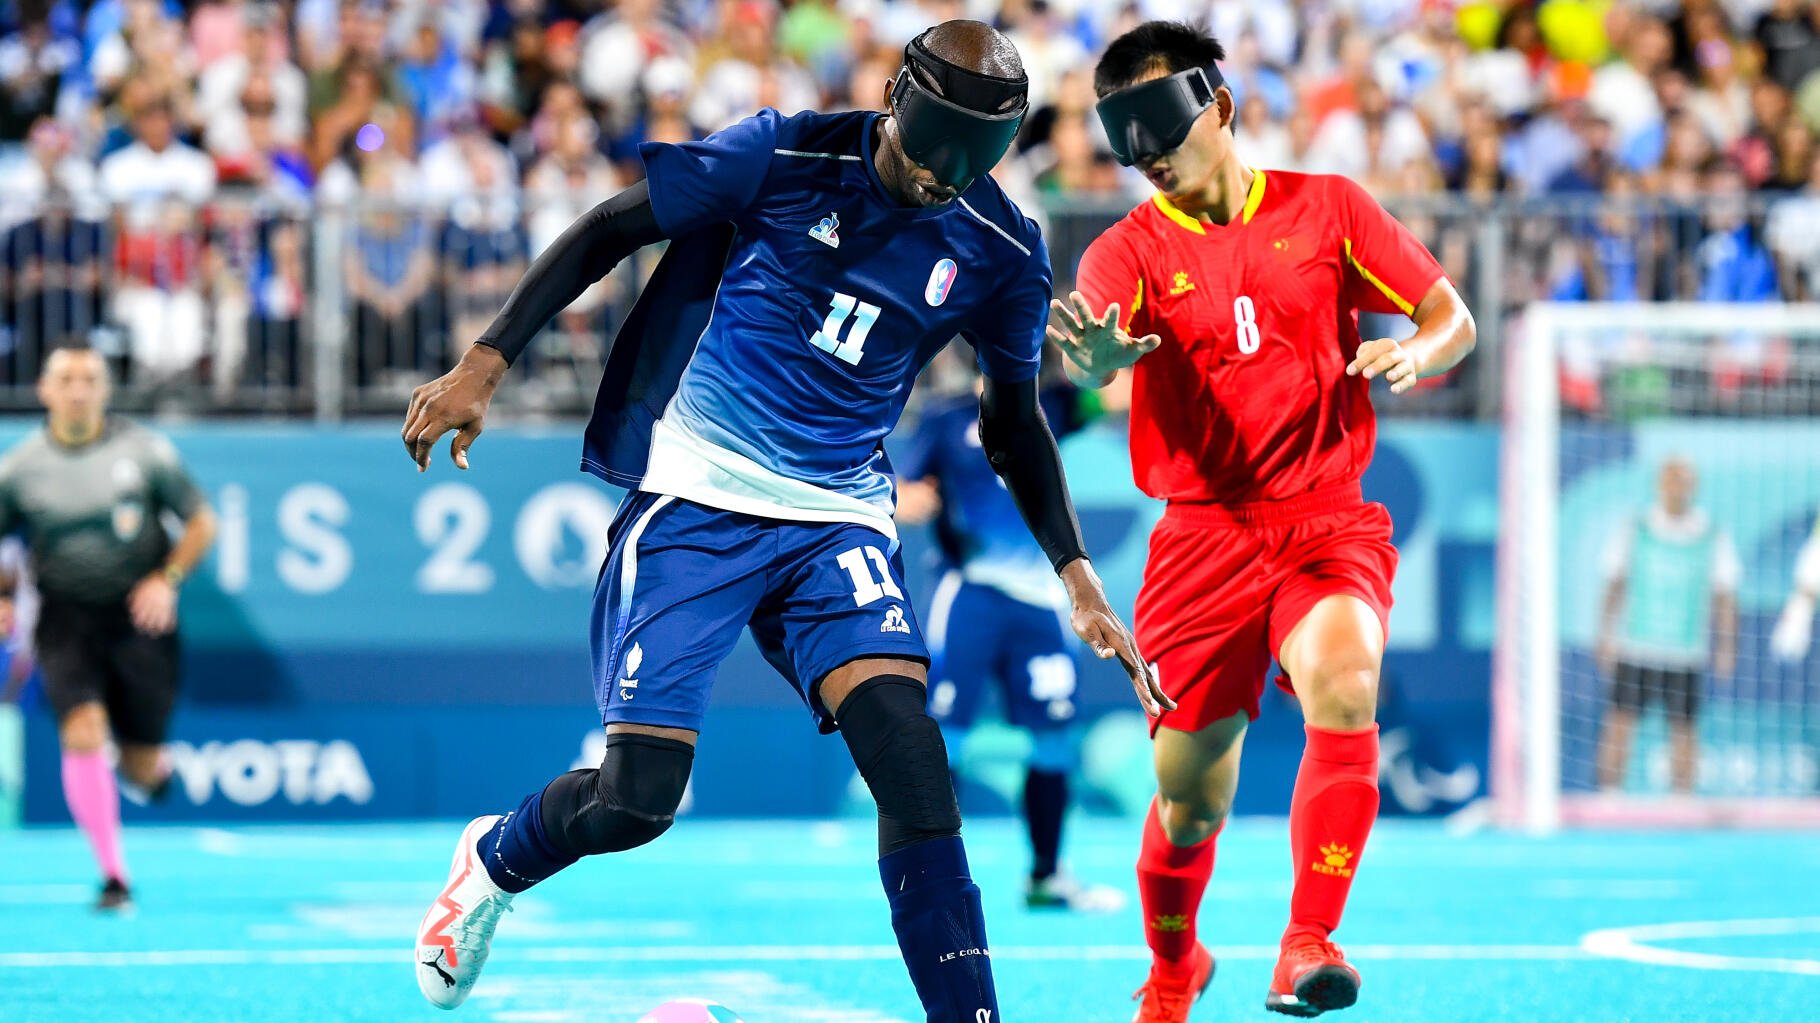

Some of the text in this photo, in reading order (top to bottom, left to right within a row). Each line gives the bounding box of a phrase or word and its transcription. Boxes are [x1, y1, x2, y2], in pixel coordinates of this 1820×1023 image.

[809, 291, 882, 366] 11
[1234, 295, 1260, 354] 8
[412, 481, 618, 595] 20
[836, 545, 905, 608] 11
[163, 738, 375, 806] YOTA
[940, 952, 956, 962] LE
